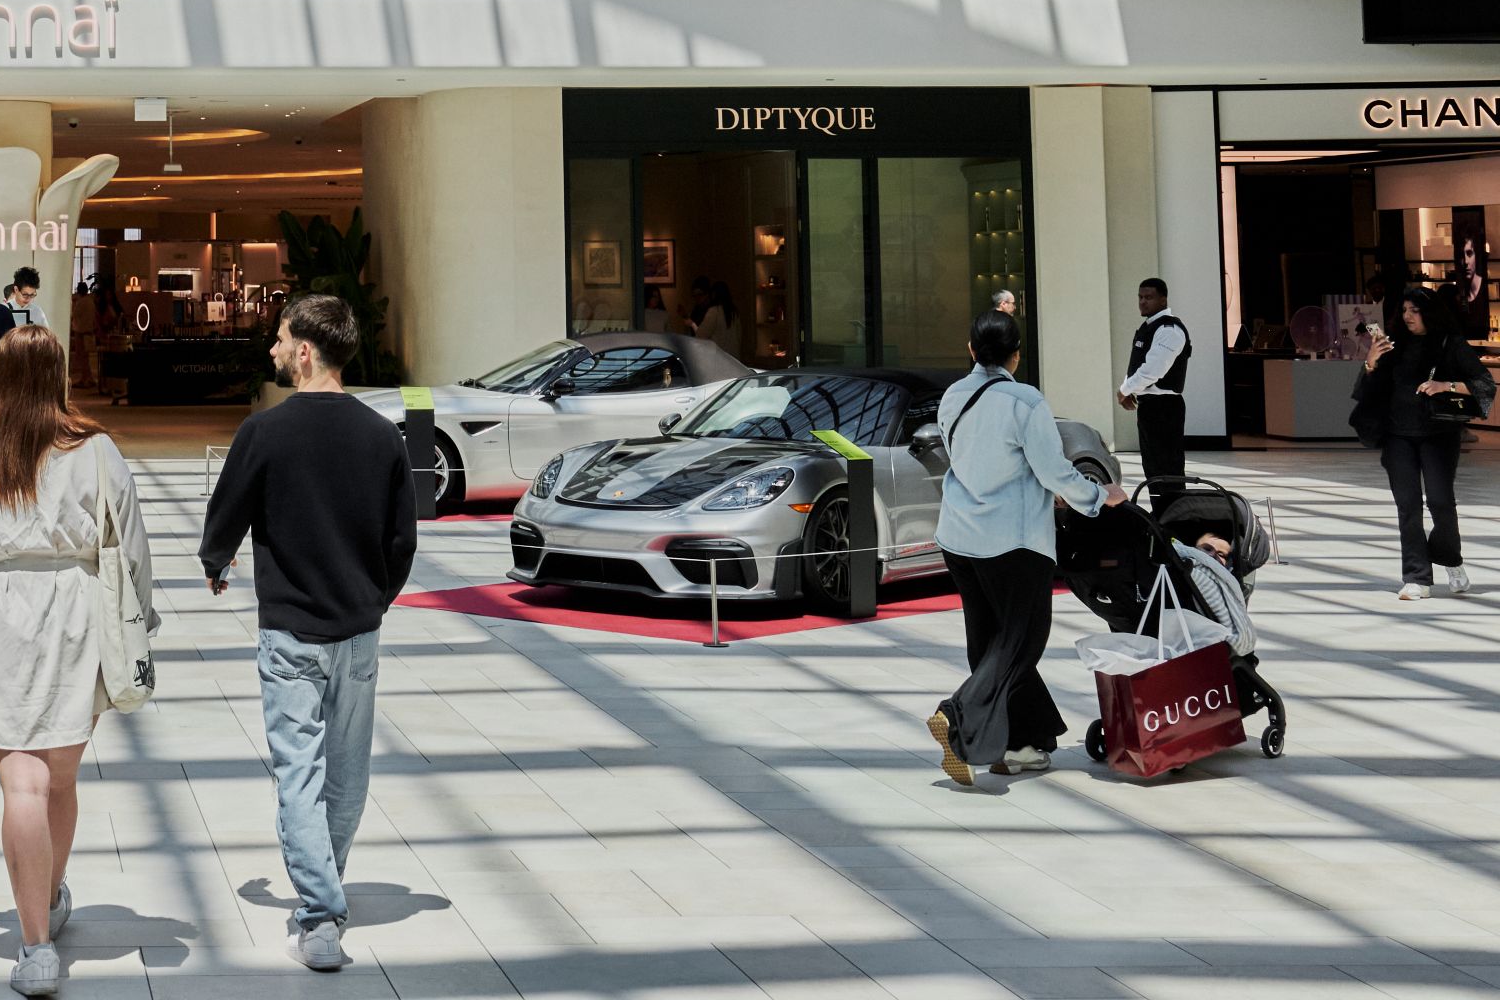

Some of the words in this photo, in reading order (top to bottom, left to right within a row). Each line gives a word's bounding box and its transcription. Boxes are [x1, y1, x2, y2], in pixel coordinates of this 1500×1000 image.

[715, 106, 876, 136] DIPTYQUE
[171, 364, 216, 374] VICTORIA
[1143, 684, 1232, 732] GUCCI
